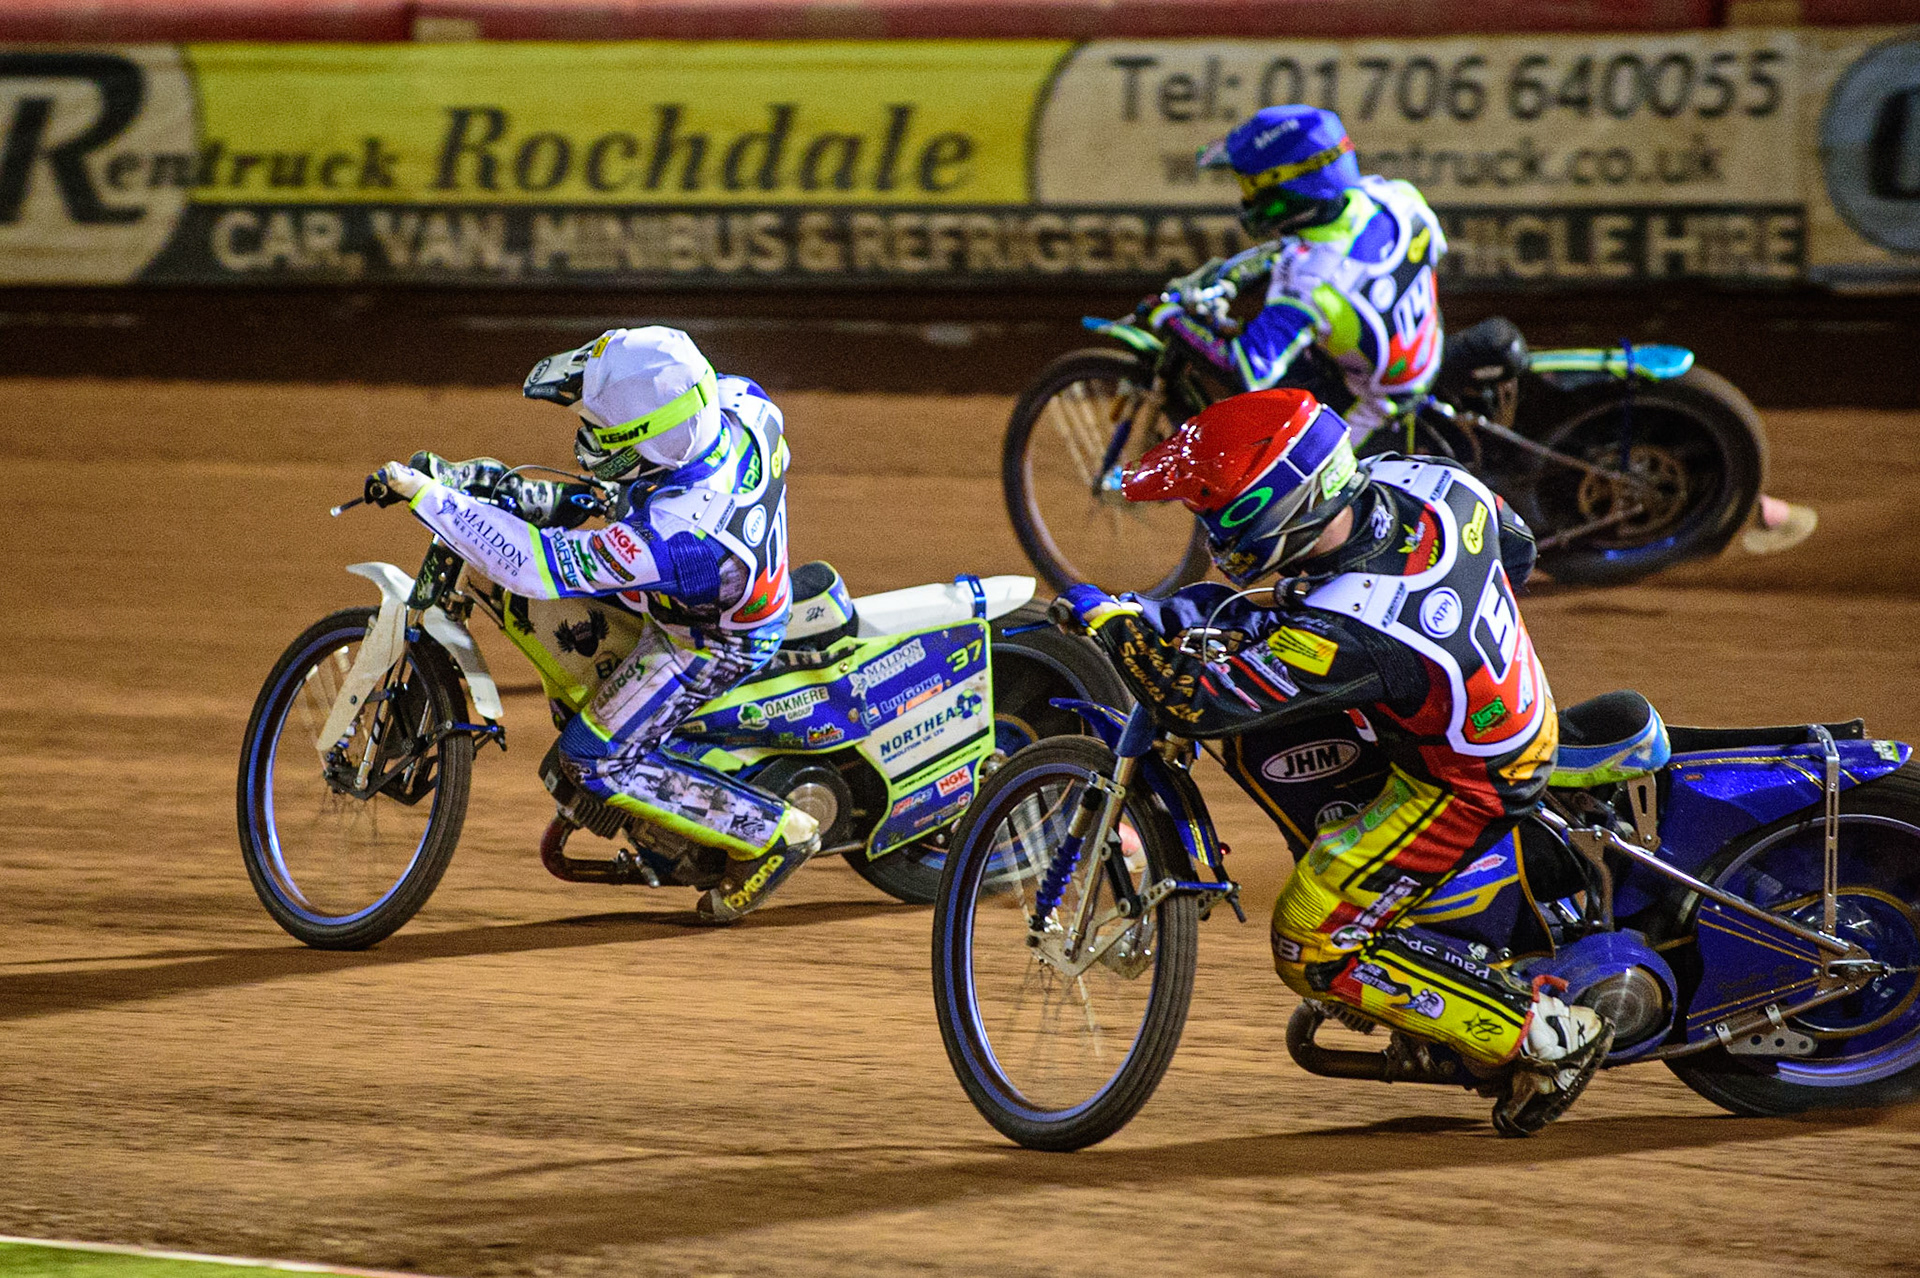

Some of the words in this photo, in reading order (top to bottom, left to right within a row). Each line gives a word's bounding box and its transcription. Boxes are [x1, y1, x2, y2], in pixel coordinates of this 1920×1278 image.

[1112, 54, 1242, 122] Tel:
[1257, 55, 1487, 122] 01706
[1507, 50, 1783, 119] 640055
[428, 101, 978, 194] Rochdale
[530, 213, 790, 273] MINIBUS
[800, 213, 843, 273] &
[850, 213, 1245, 274] REFRIGERAT
[1438, 214, 1632, 278] HICLE
[1646, 214, 1799, 278] HIRE
[600, 421, 650, 446] KENNY
[453, 517, 492, 562] METALS
[496, 558, 520, 578] LTD
[458, 507, 529, 569] MALDON
[609, 524, 643, 561] NGK
[1431, 598, 1453, 628] ATPI
[866, 642, 921, 677] MALDON
[946, 638, 983, 673] 37
[765, 687, 828, 717] OAKMERE
[787, 706, 812, 720] GROUP
[1284, 744, 1341, 777] JHM
[939, 768, 968, 791] NGK
